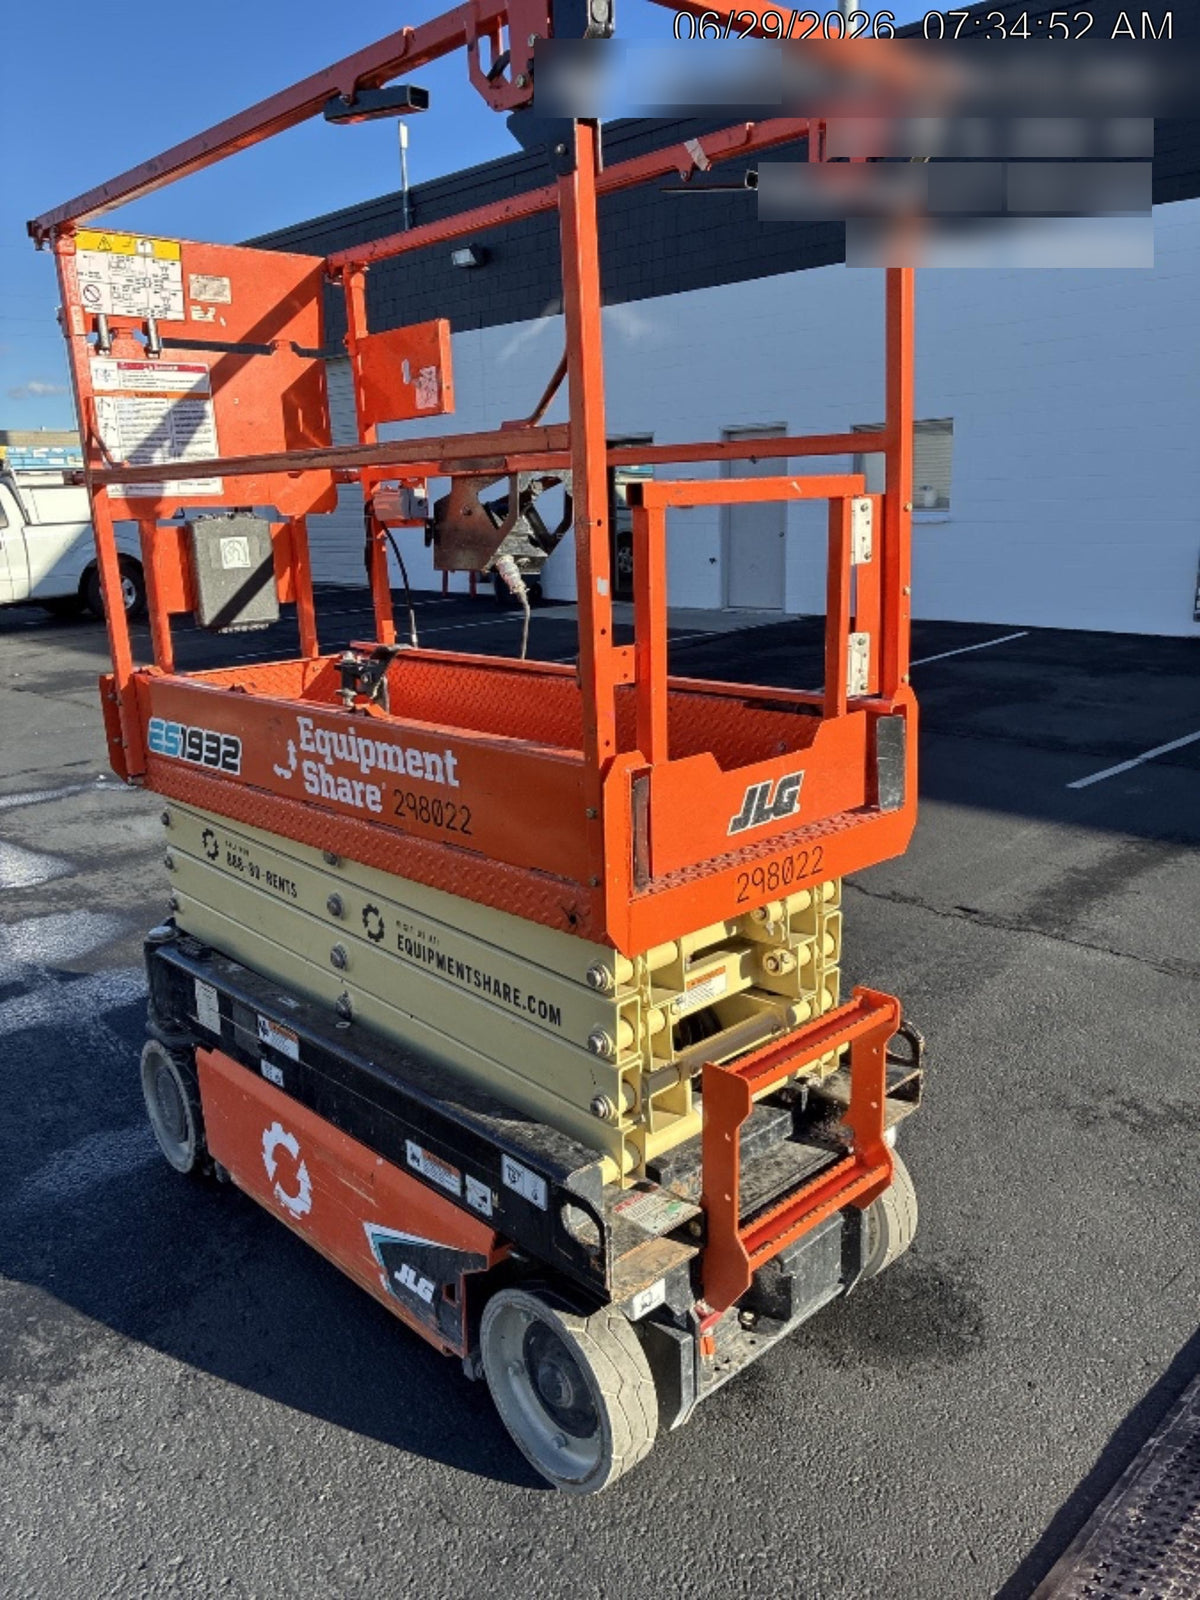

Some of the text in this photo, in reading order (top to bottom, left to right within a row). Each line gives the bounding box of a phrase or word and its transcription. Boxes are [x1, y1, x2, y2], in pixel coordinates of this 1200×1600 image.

[149, 717, 242, 776] ES1932
[297, 716, 460, 787] Equipment
[302, 760, 383, 813] Share
[393, 788, 473, 835] 298022
[727, 769, 805, 836] JLG
[736, 845, 824, 904] 298022
[397, 933, 562, 1027] EQUIPMENTSHARE.COM
[394, 1263, 436, 1304] JLG
